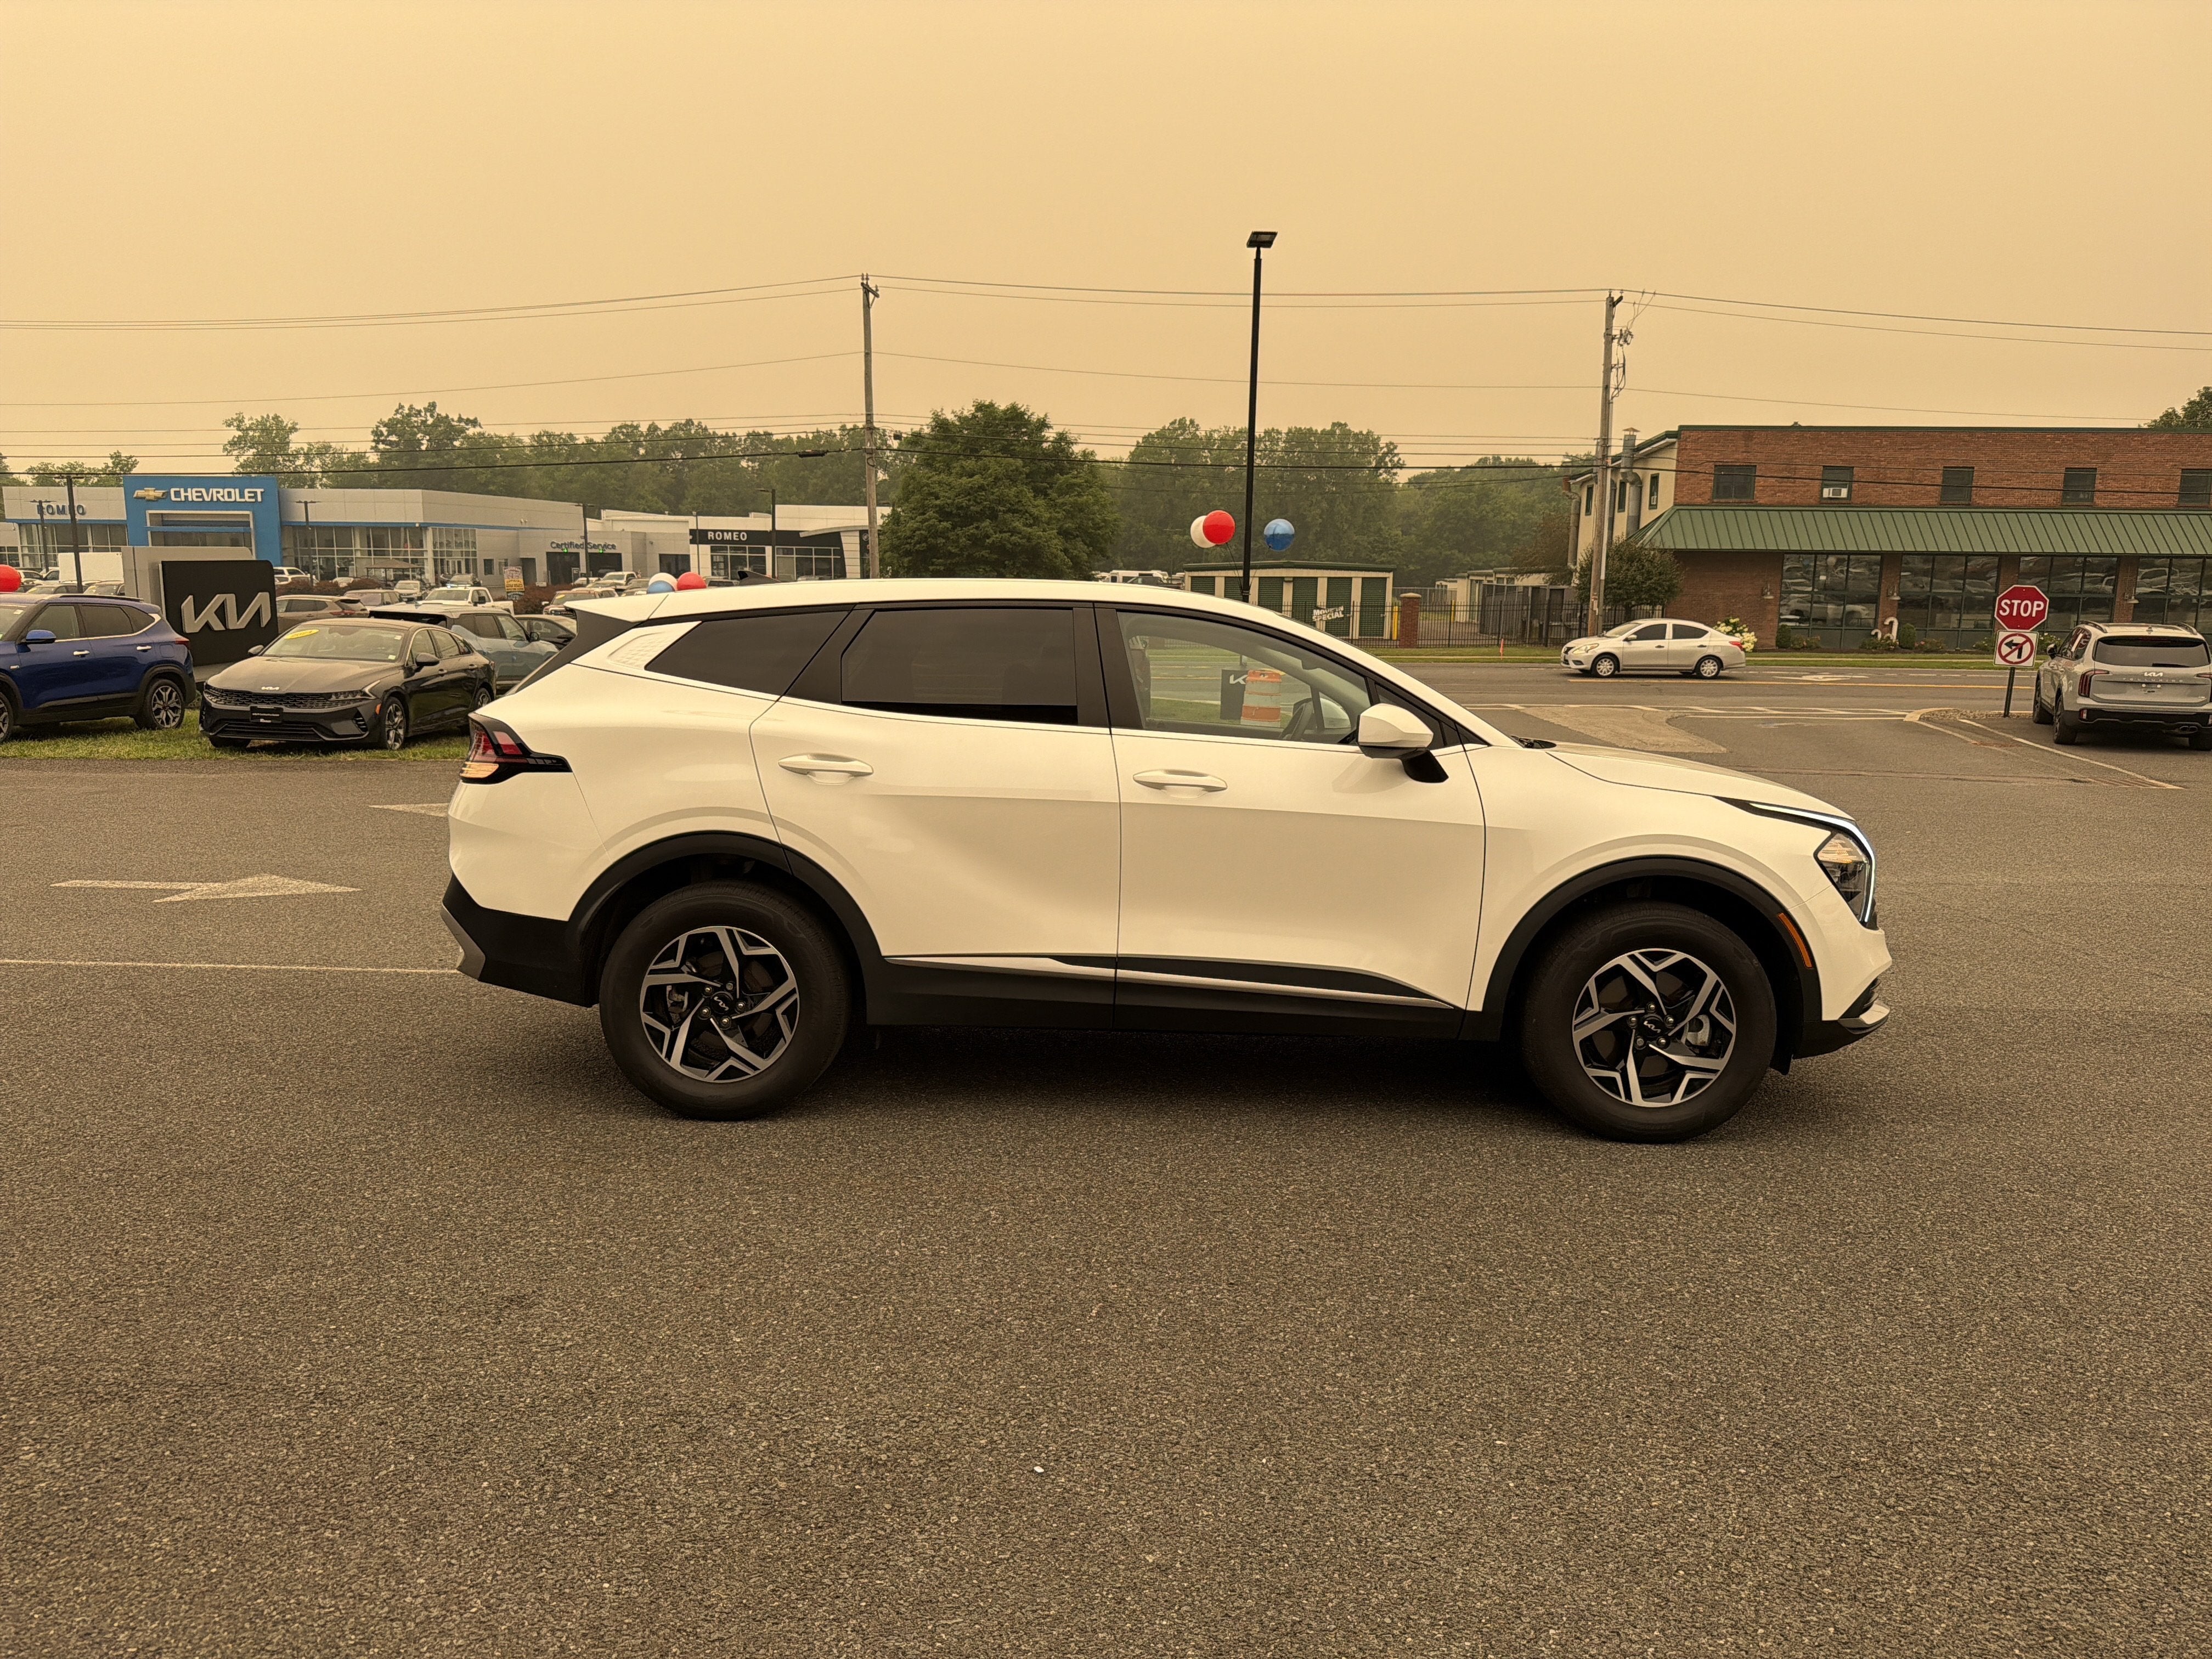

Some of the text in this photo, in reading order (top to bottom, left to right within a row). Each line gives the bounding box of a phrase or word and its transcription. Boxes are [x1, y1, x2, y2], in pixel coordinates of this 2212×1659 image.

[170, 488, 264, 502] CHEVROLET
[708, 531, 747, 541] ROMEO
[181, 592, 271, 633] KIA
[1999, 599, 2044, 617] STOP
[1312, 611, 1344, 621] SPECIAL
